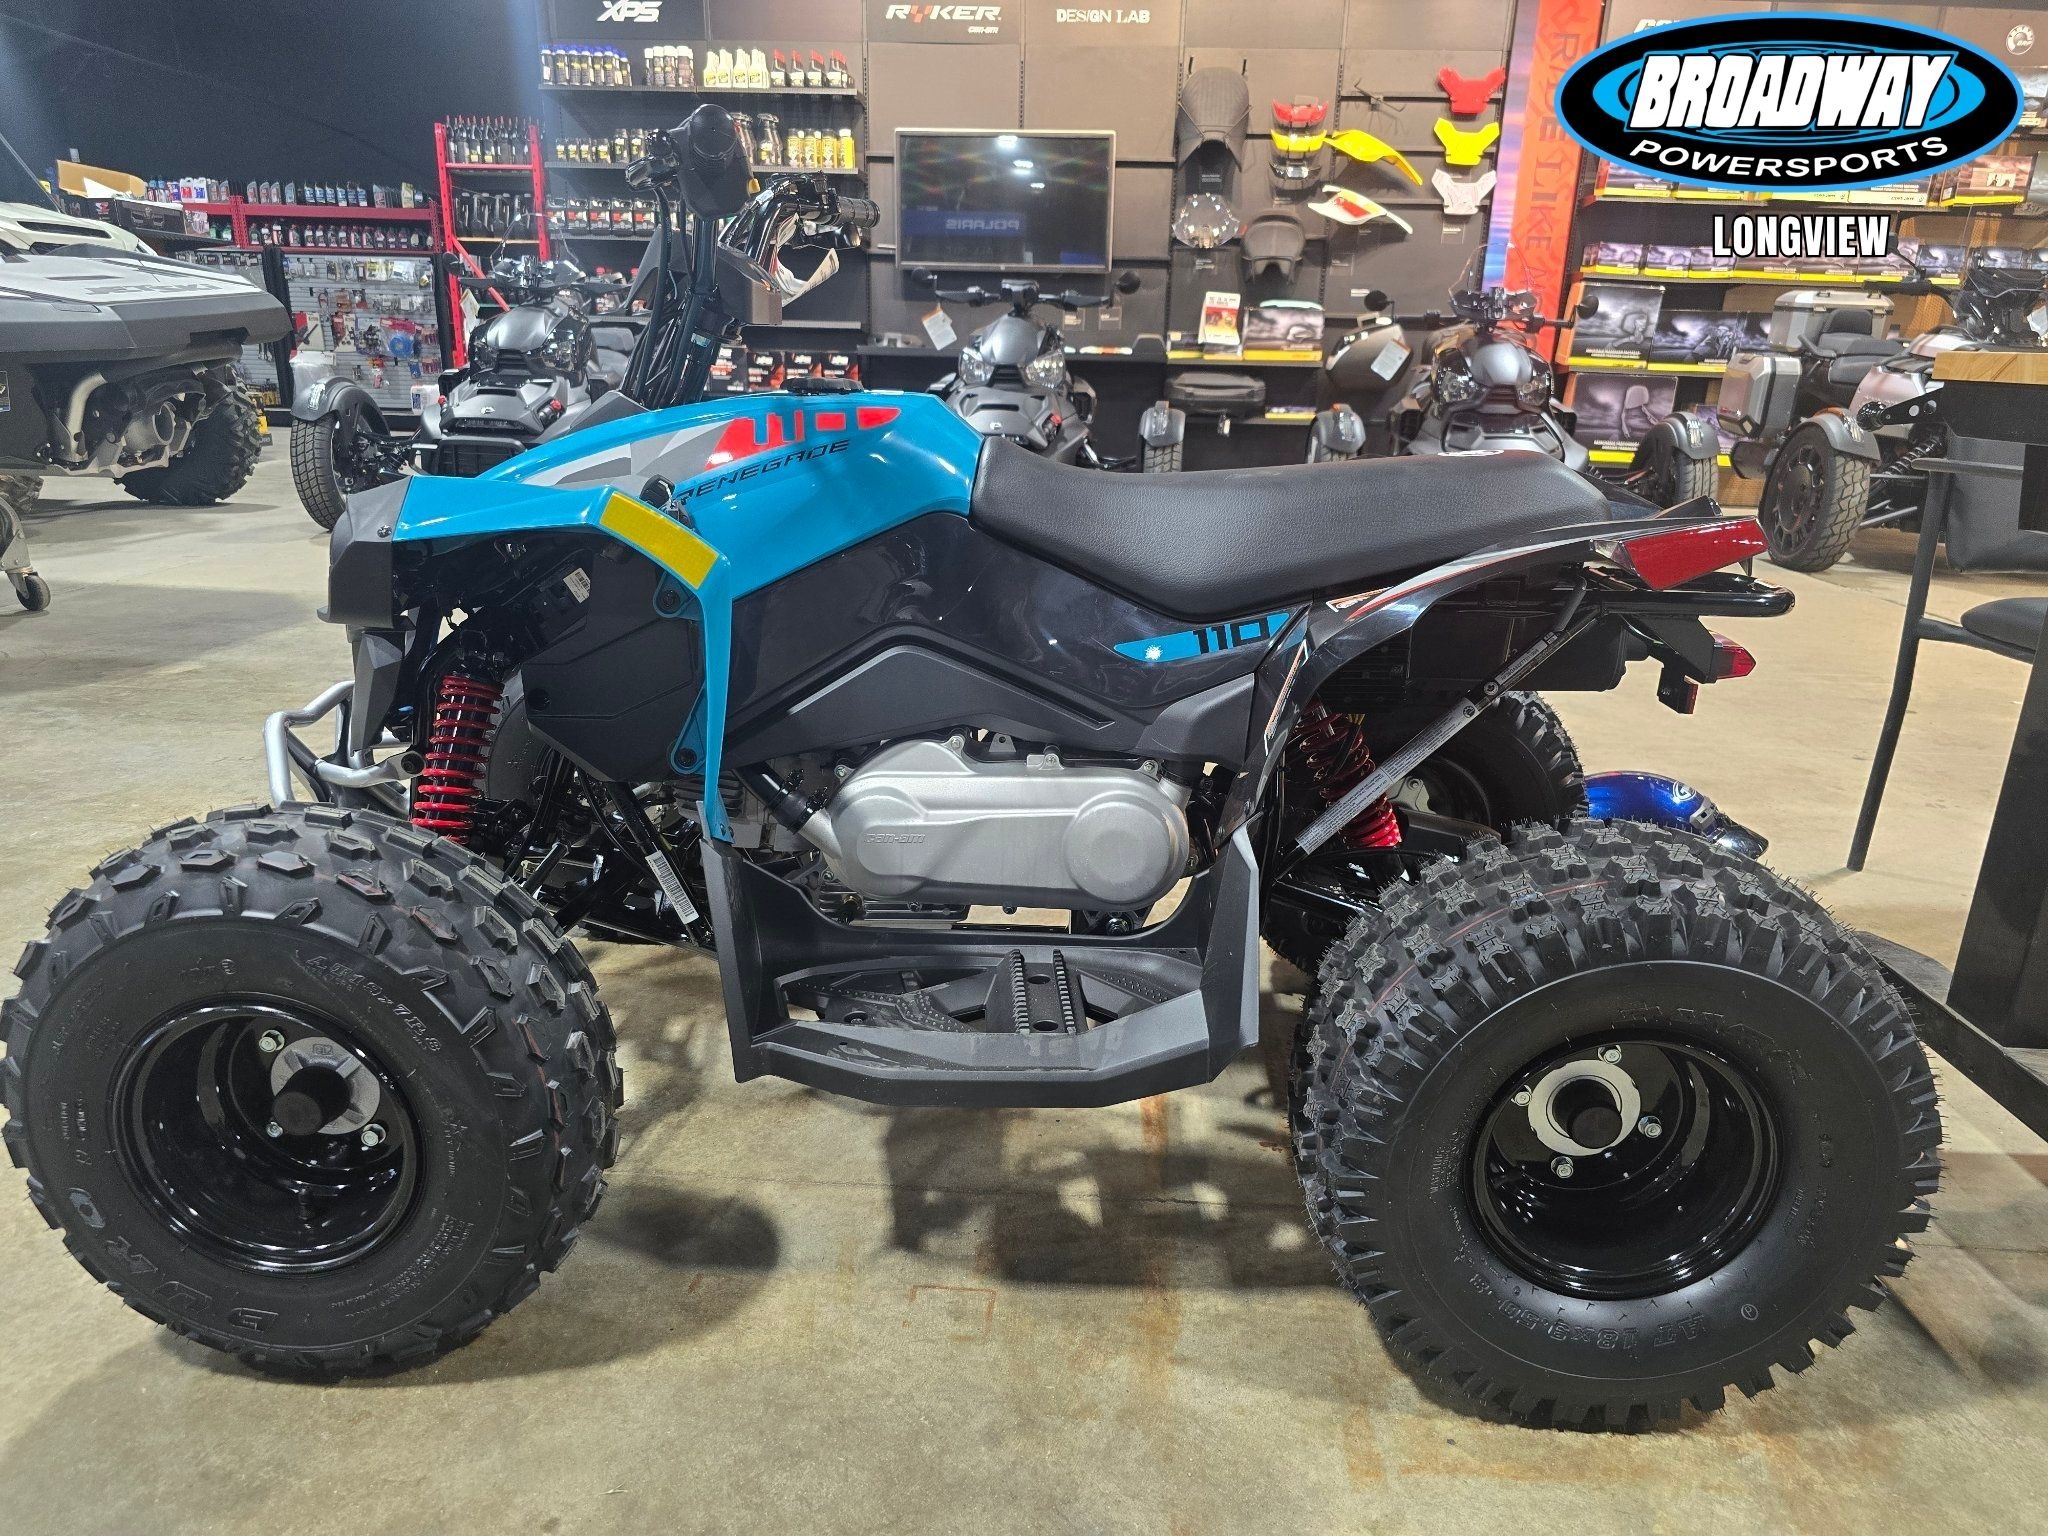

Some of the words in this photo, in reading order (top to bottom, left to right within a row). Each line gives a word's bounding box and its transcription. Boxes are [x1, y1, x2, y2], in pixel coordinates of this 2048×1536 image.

[597, 0, 663, 23] XPS
[1056, 8, 1113, 24] DESIGN
[1116, 9, 1151, 24] LAB
[675, 439, 851, 505] RENEGADE
[1192, 617, 1271, 655] 110
